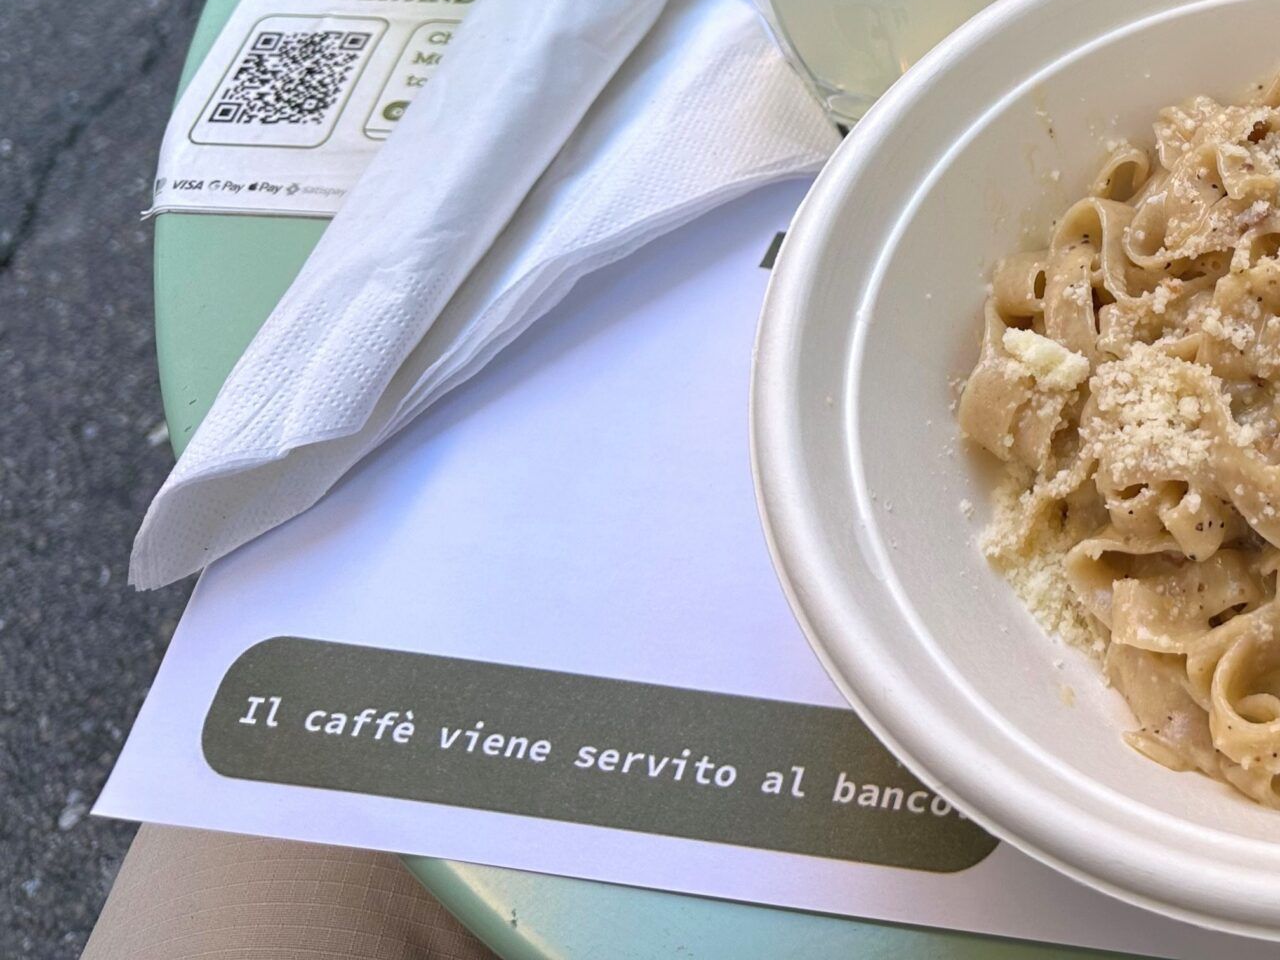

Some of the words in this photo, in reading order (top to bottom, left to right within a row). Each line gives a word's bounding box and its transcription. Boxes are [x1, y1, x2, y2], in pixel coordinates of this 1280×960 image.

[172, 180, 204, 191] VISA
[222, 181, 245, 194] Pay
[258, 182, 283, 195] Pay
[239, 696, 282, 727] Il
[304, 708, 415, 743] caffè
[439, 721, 552, 763] viene
[573, 744, 737, 788] servito
[761, 766, 806, 798] al
